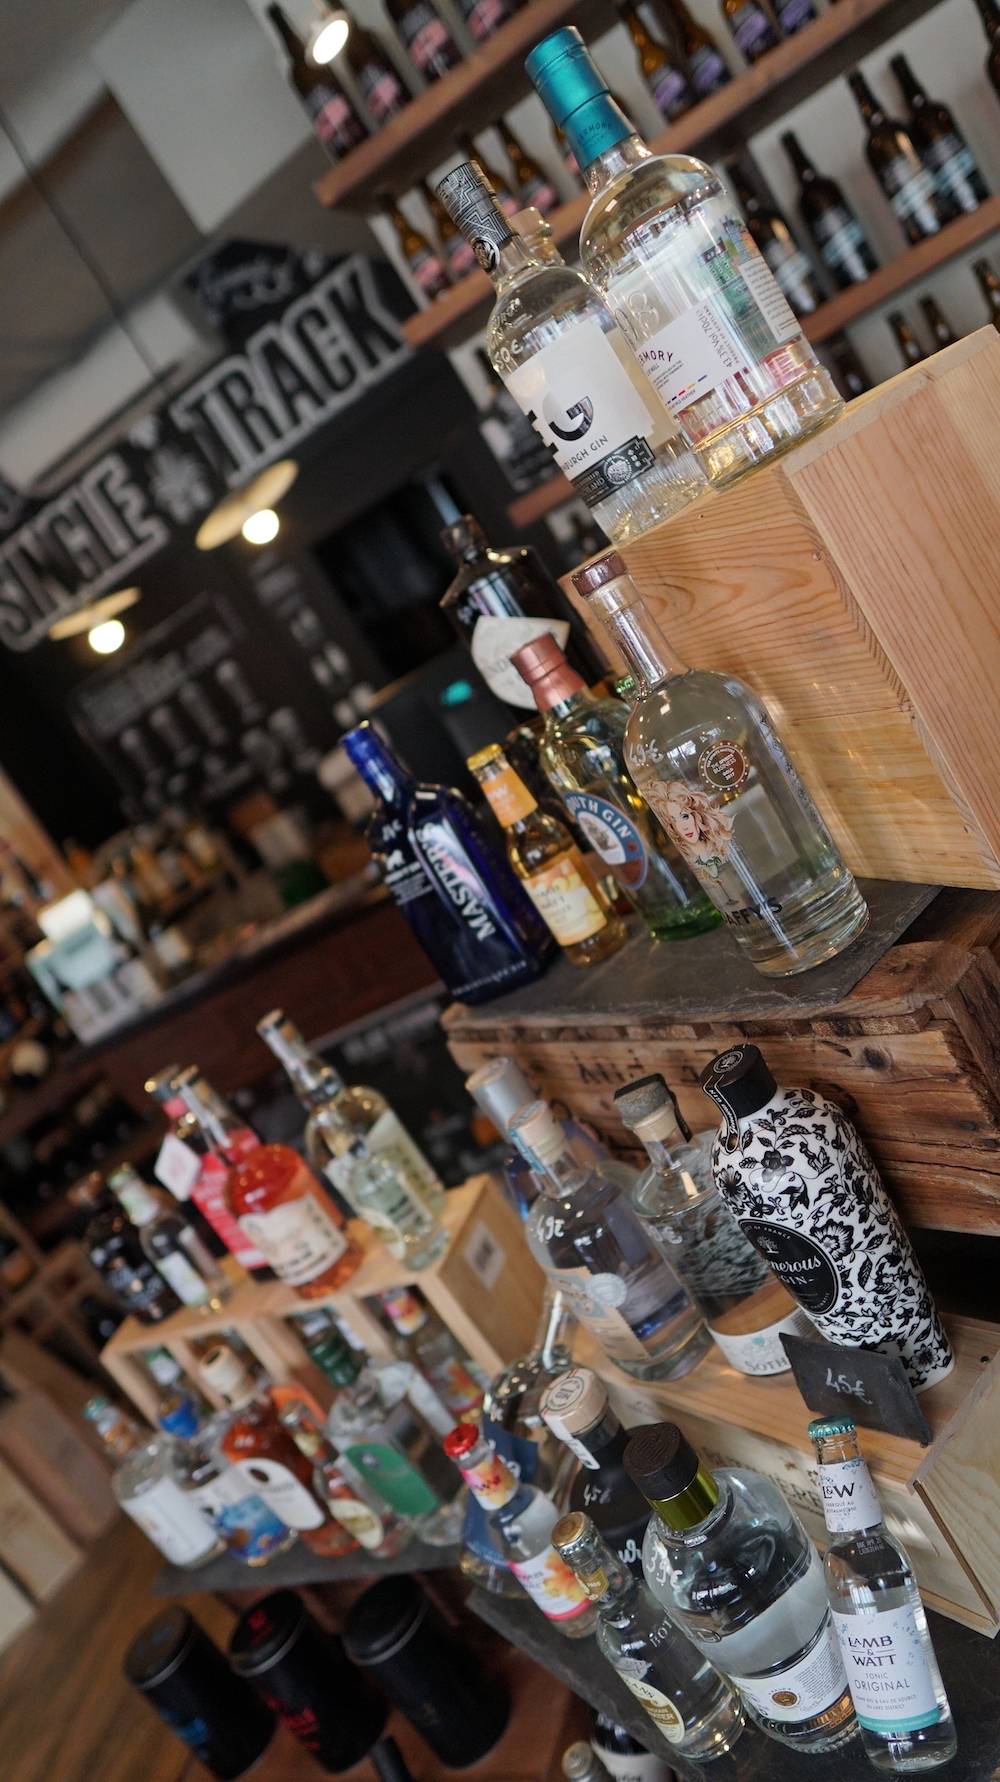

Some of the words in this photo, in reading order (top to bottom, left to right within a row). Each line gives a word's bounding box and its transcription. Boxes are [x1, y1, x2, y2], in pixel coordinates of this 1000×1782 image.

[167, 254, 413, 491] TRACK
[589, 434, 609, 452] GIN
[602, 808, 632, 839] GIN
[708, 1088, 722, 1103] GIN
[769, 1255, 822, 1274] nerous
[744, 1357, 788, 1372] SOTH
[824, 1366, 874, 1406] 45€
[822, 1482, 855, 1499] L&W
[847, 1635, 893, 1648] LAMB
[867, 1648, 875, 1656] &
[852, 1654, 896, 1667] WATT
[865, 1672, 889, 1680] TONIC
[854, 1679, 911, 1692] ORIGINAL
